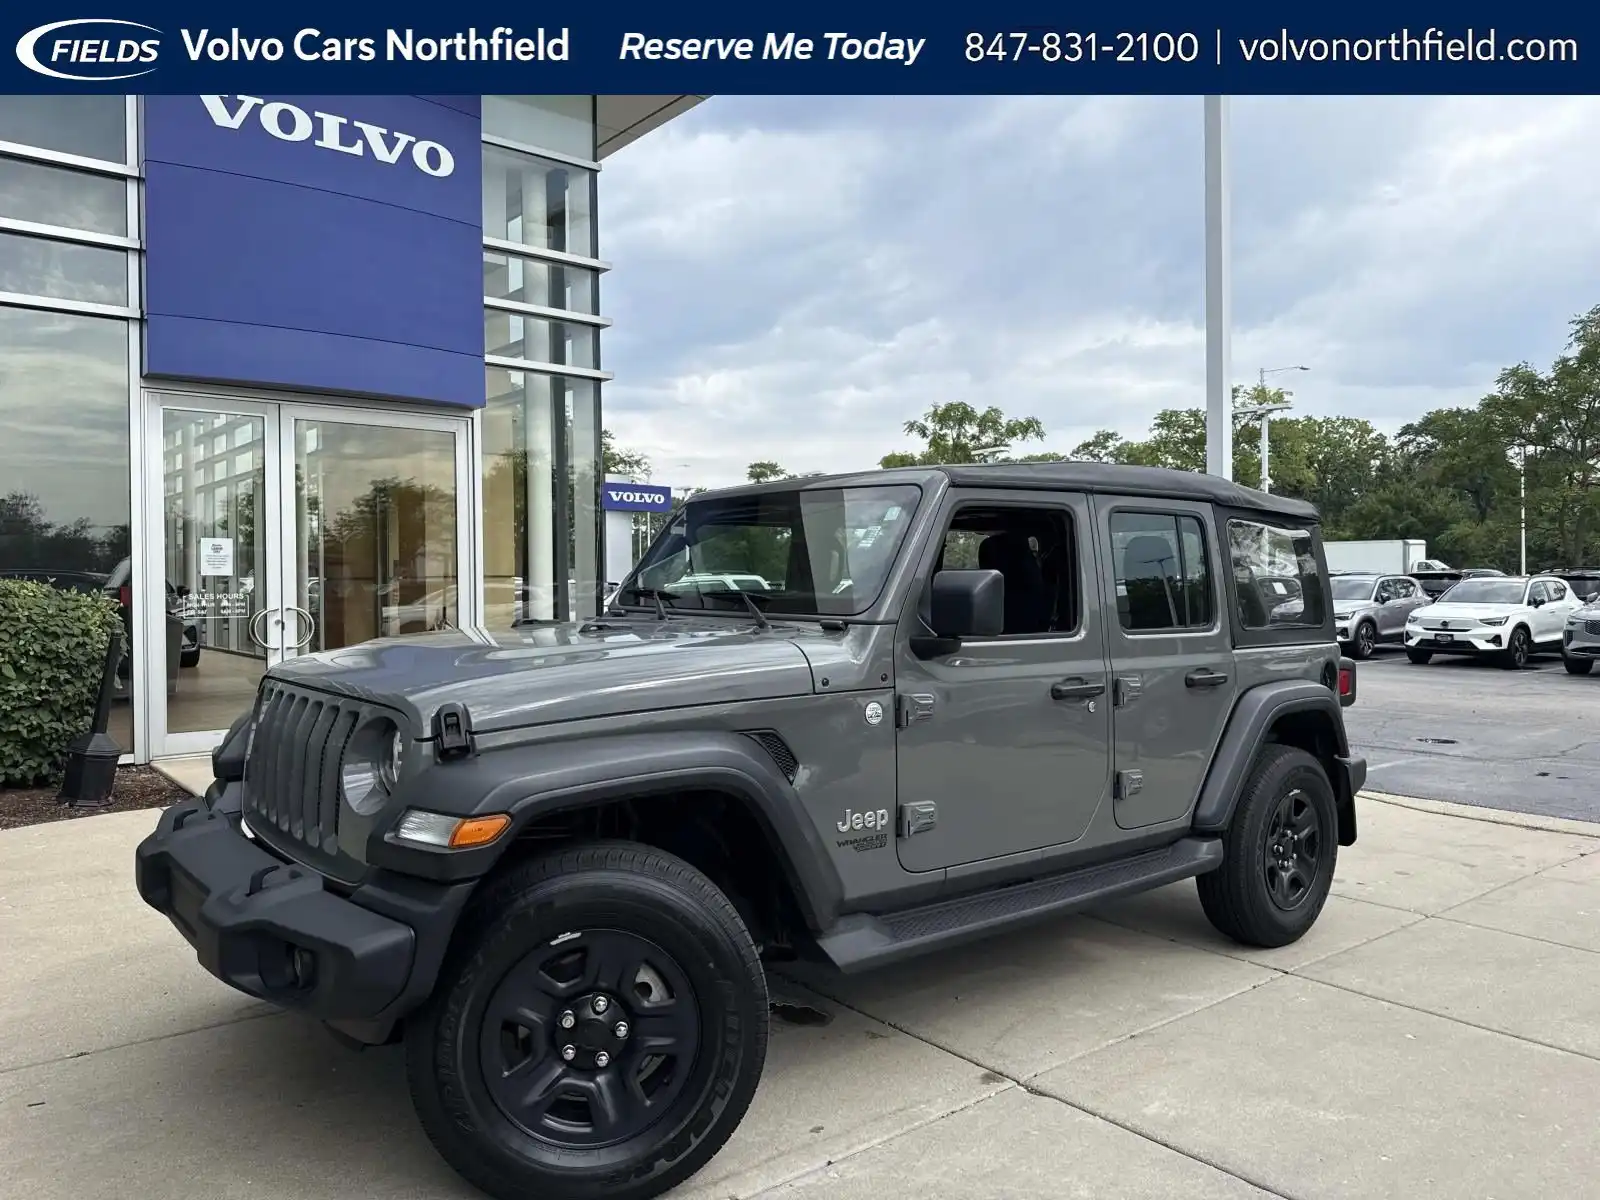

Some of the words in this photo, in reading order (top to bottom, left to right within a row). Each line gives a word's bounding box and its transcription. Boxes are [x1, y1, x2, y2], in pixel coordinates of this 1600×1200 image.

[199, 94, 455, 177] VOLVO
[607, 490, 665, 504] VOLVO
[836, 809, 889, 832] Jeep
